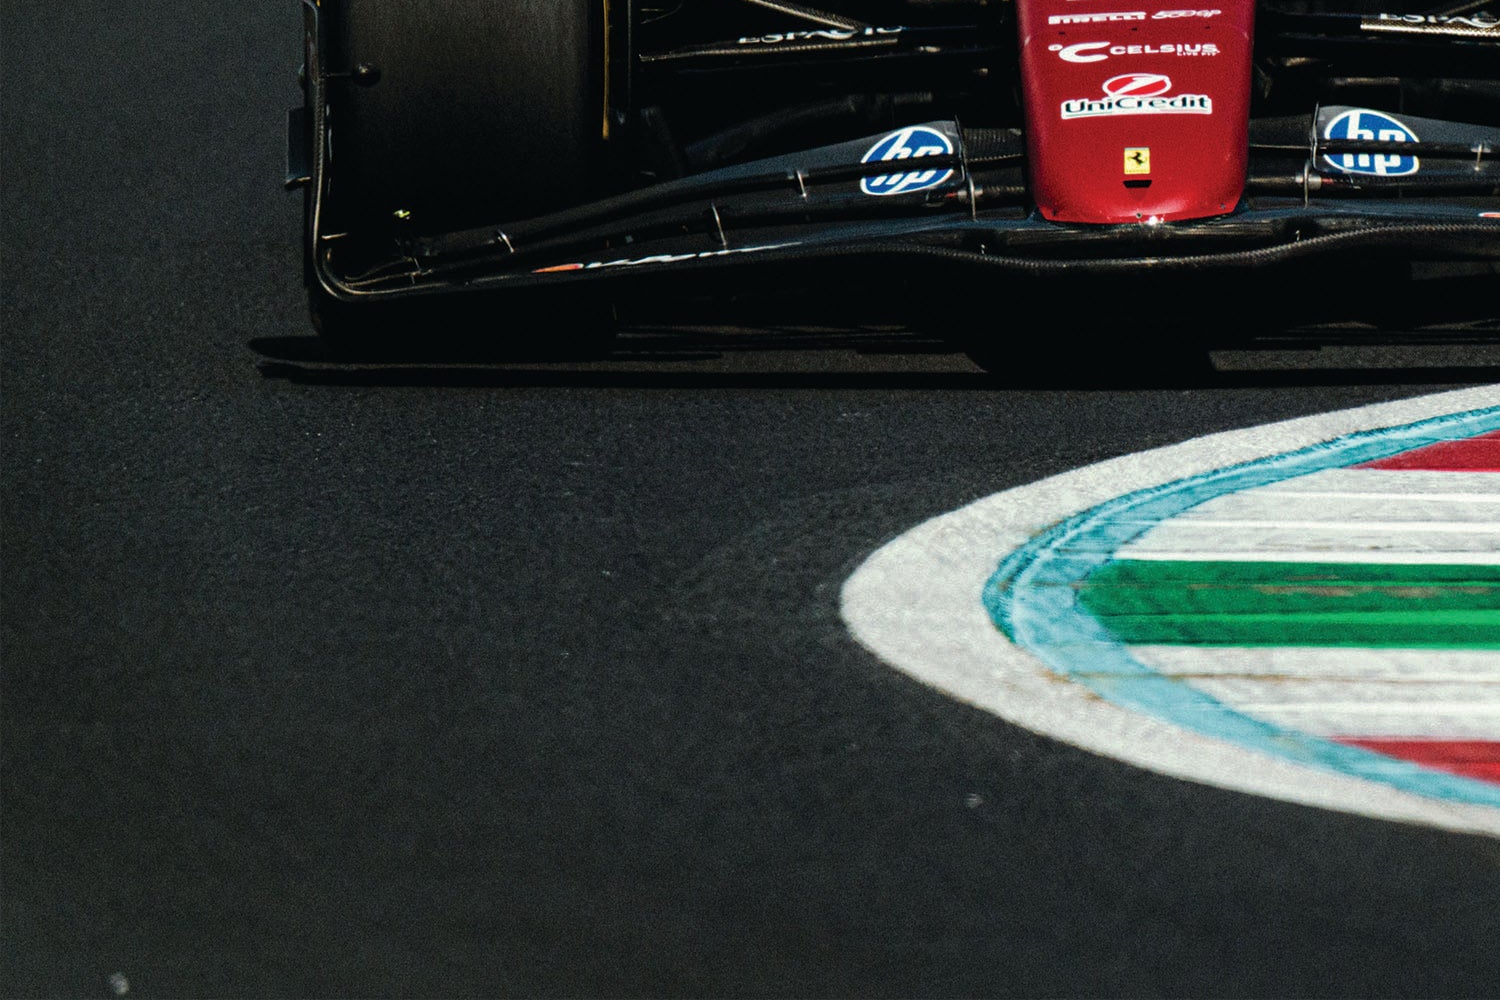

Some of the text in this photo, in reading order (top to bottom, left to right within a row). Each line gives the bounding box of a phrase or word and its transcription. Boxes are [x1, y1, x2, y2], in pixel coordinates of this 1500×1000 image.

[1109, 44, 1219, 55] CELSIUS
[1065, 96, 1208, 113] UniCredit
[870, 128, 944, 193] hp
[1343, 111, 1406, 175] hp
